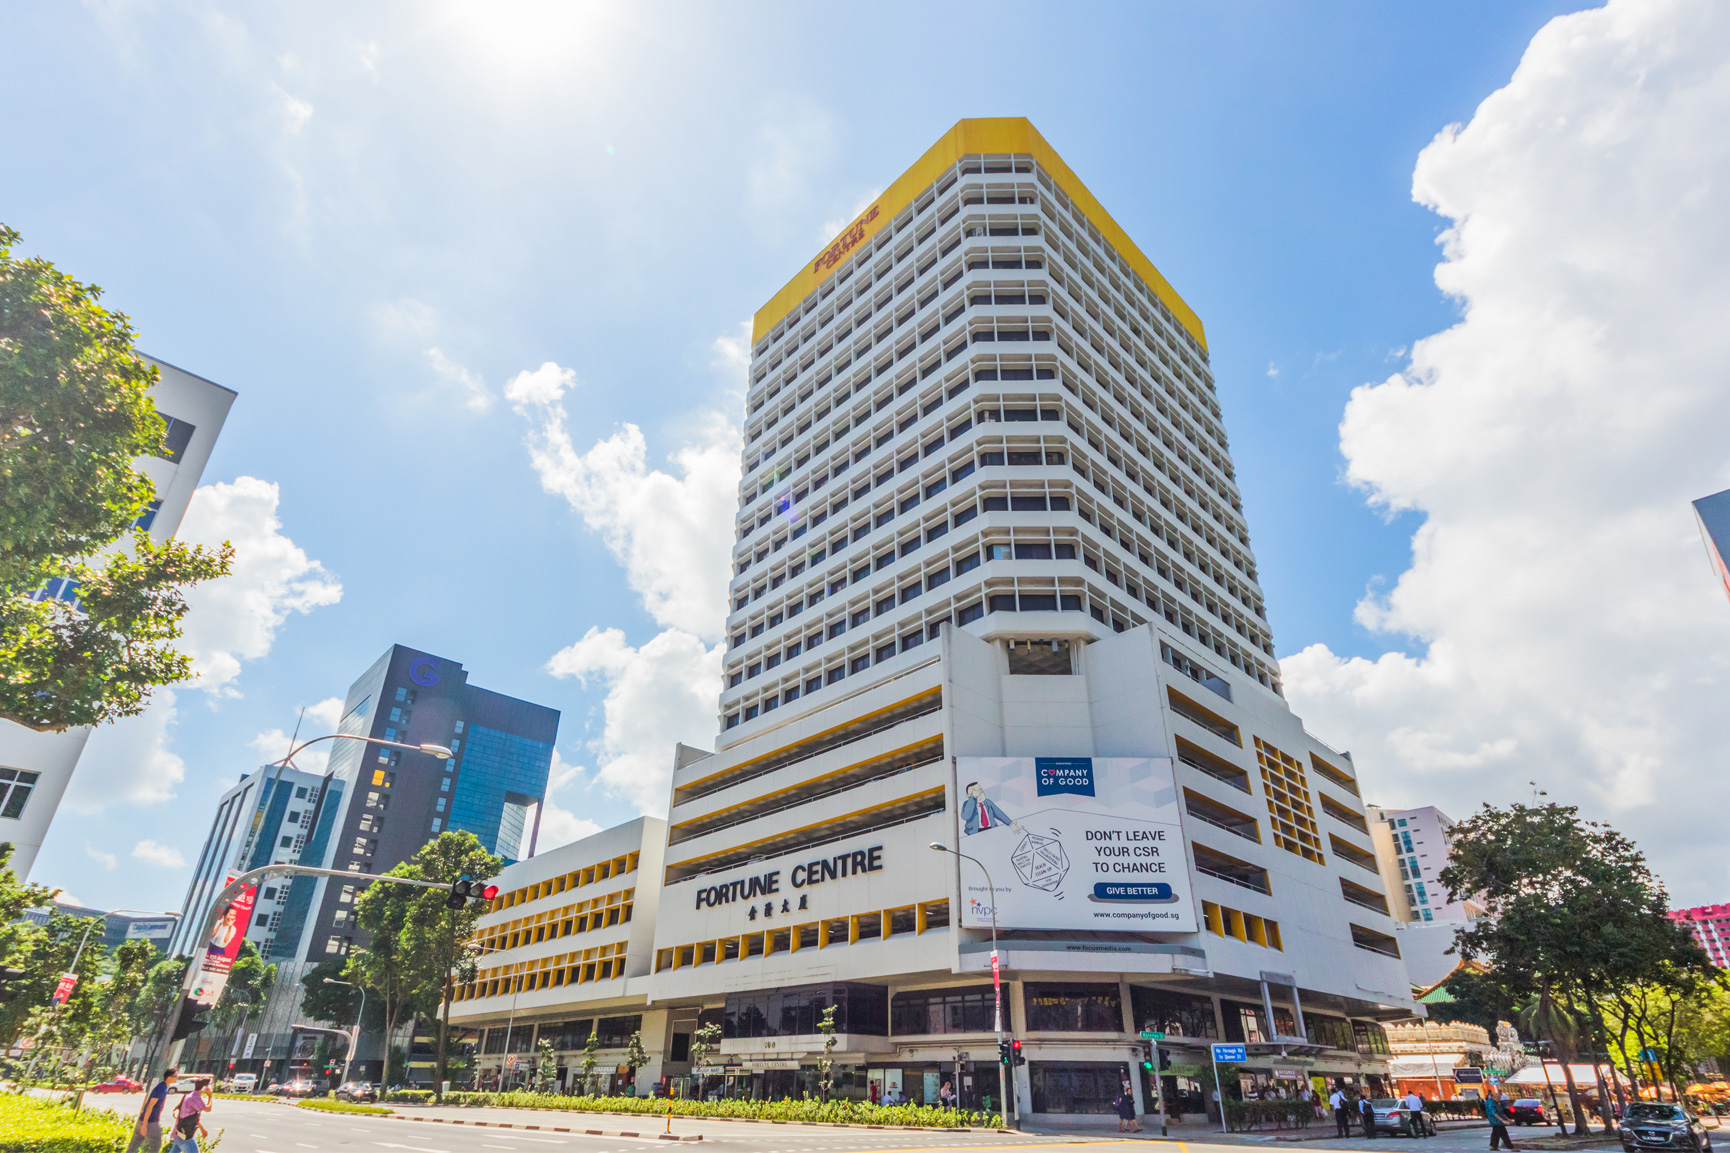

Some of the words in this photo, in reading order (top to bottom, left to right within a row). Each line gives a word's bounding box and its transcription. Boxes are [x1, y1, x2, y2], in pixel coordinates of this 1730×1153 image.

[814, 205, 879, 274] FORTUNE
[826, 229, 865, 269] CENTRE
[409, 657, 441, 687] G
[1041, 777, 1055, 785] OF
[1058, 777, 1089, 785] GOOD
[1085, 830, 1122, 841] DON'T
[1125, 830, 1166, 841] LEAVE
[1094, 846, 1131, 857] YOUR
[1133, 846, 1160, 857] CSR
[1092, 862, 1109, 873] TO
[1113, 862, 1166, 873] CHANCE
[695, 870, 780, 910] FORTUNE
[790, 845, 883, 888] CENTRE
[1106, 887, 1126, 895] GIVE
[1127, 887, 1159, 895] BETTER
[971, 906, 998, 917] nvpc
[1093, 911, 1179, 920] www.companyofgood.sg
